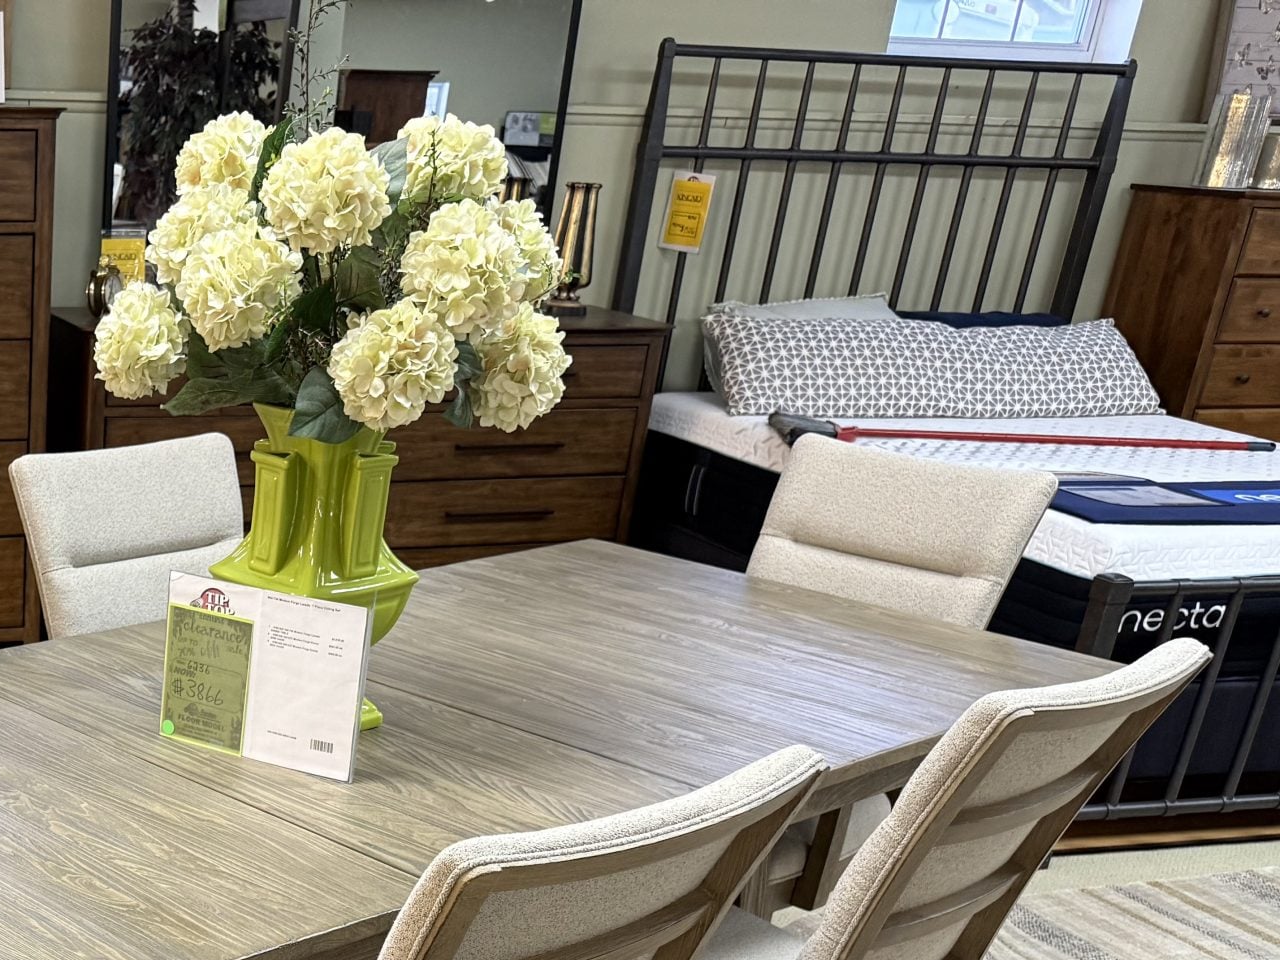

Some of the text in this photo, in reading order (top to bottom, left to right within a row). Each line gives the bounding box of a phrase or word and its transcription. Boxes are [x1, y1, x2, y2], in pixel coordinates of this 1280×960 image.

[207, 591, 230, 606] TIP
[206, 603, 237, 615] TOP
[1117, 601, 1227, 634] necta
